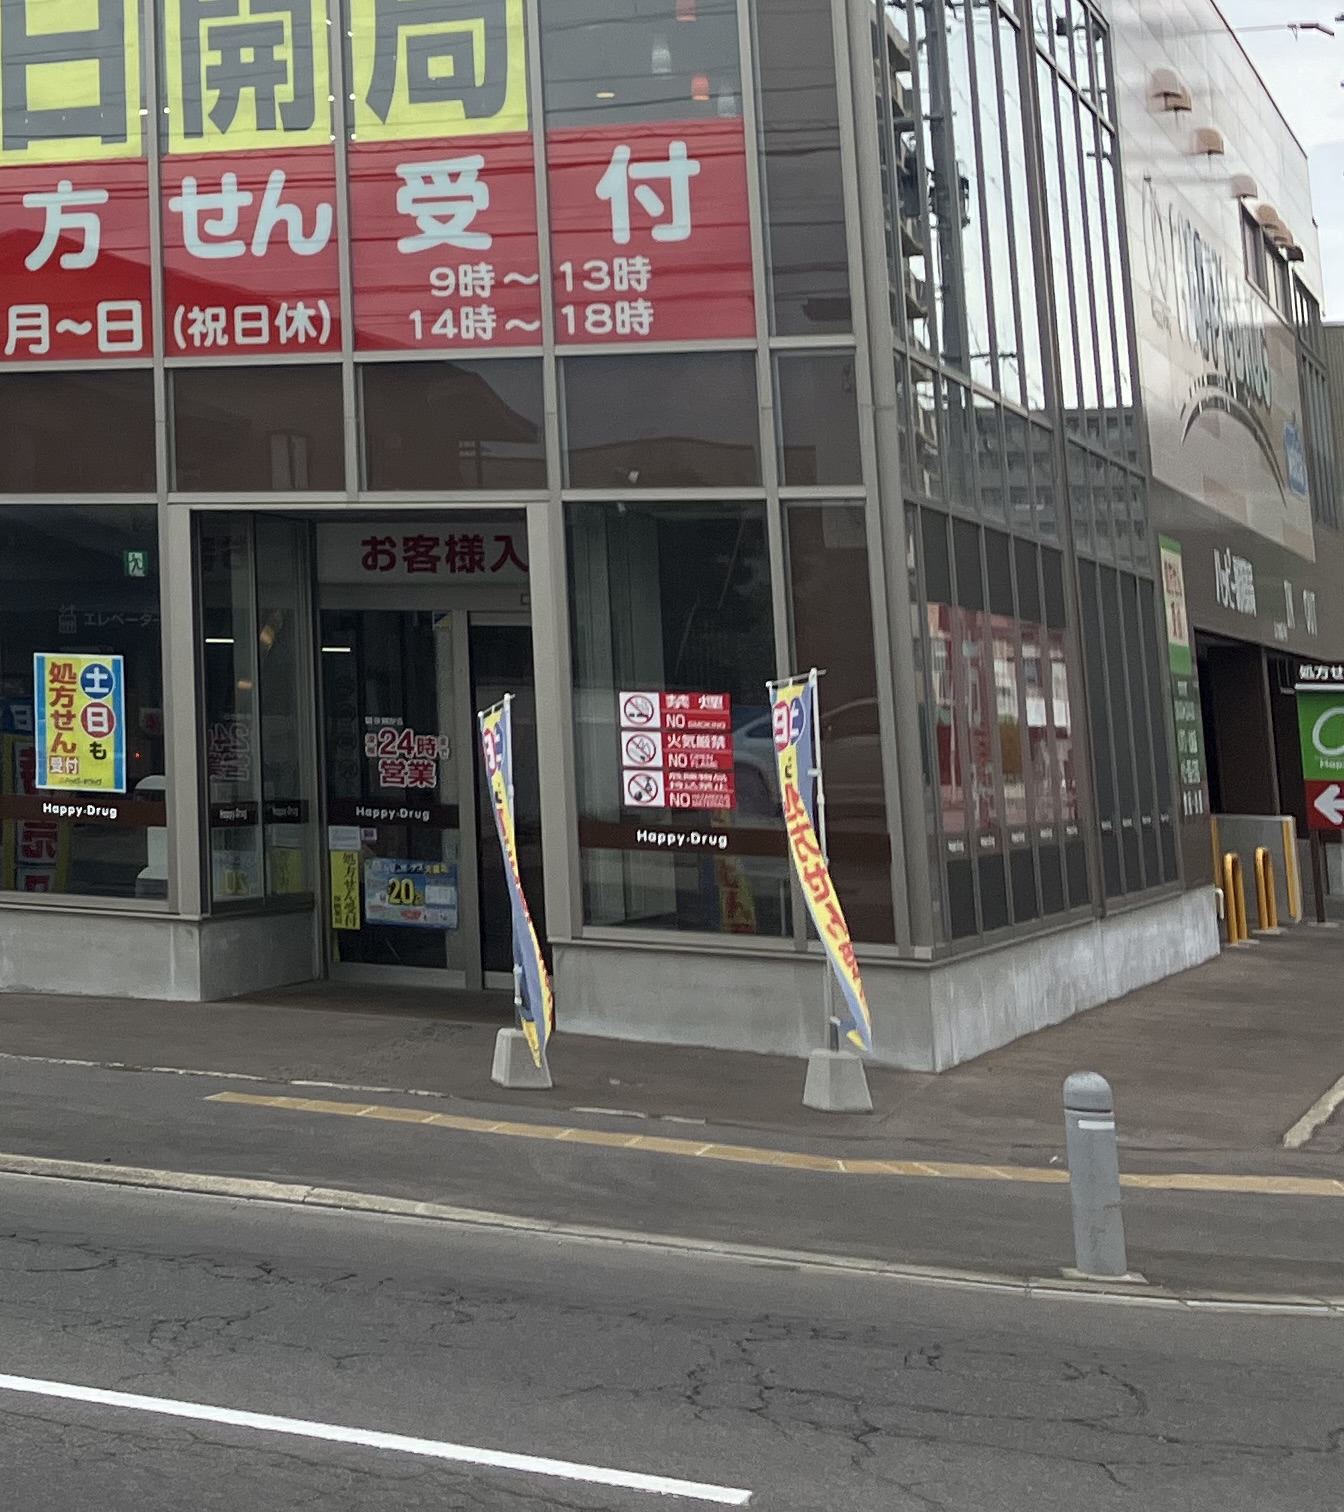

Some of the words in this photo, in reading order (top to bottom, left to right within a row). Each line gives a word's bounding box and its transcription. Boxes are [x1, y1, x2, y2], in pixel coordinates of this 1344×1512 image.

[49, 662, 78, 754] 処方せん
[665, 713, 686, 729] NO
[49, 755, 79, 774] 受付
[668, 753, 688, 768] NO
[378, 758, 437, 788] 営業
[669, 793, 691, 808] NO
